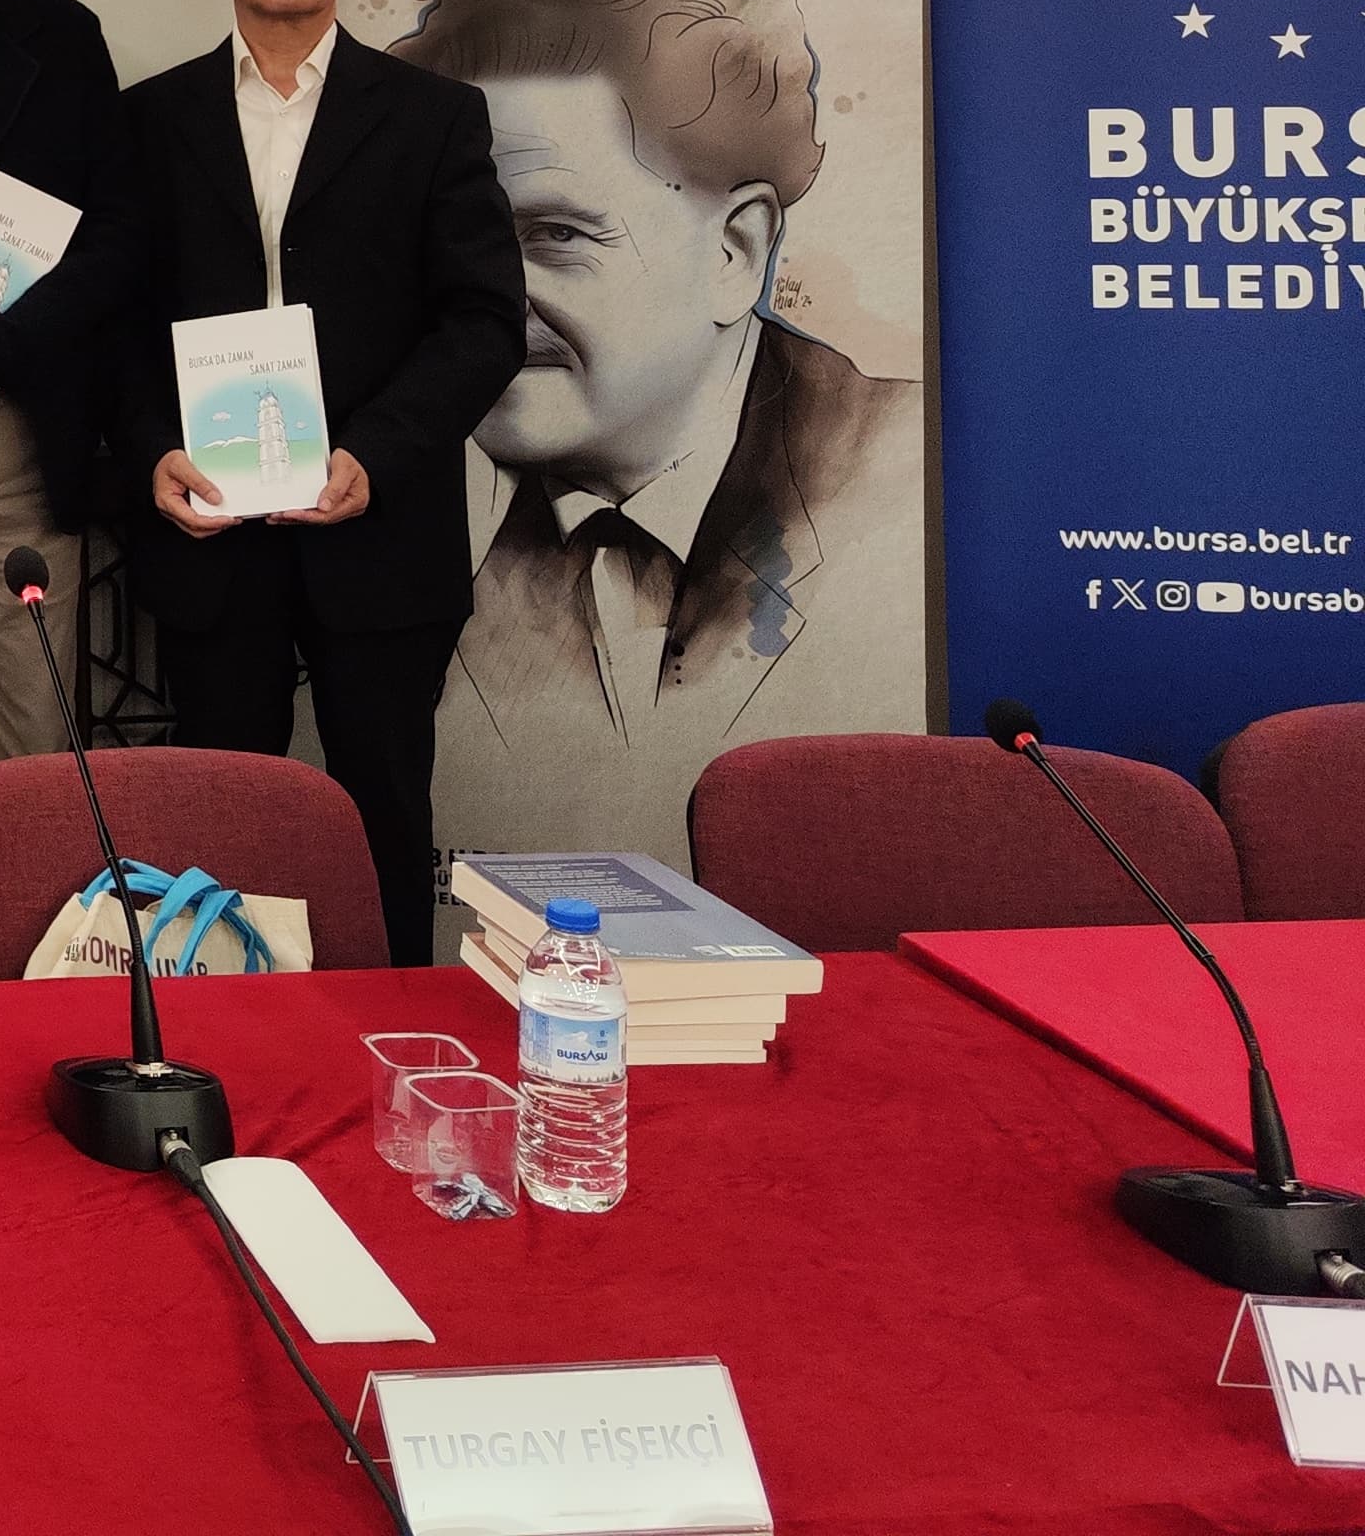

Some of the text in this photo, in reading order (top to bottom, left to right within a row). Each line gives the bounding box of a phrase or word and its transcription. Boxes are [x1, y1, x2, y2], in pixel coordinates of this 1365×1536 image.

[0, 232, 27, 252] SANAT
[227, 350, 254, 364] ZAMAN
[250, 362, 275, 376] SANAT
[1059, 526, 1352, 556] www.bursa.bel.tr
[404, 1414, 725, 1471] TURGAY FİŞEKÇİ
